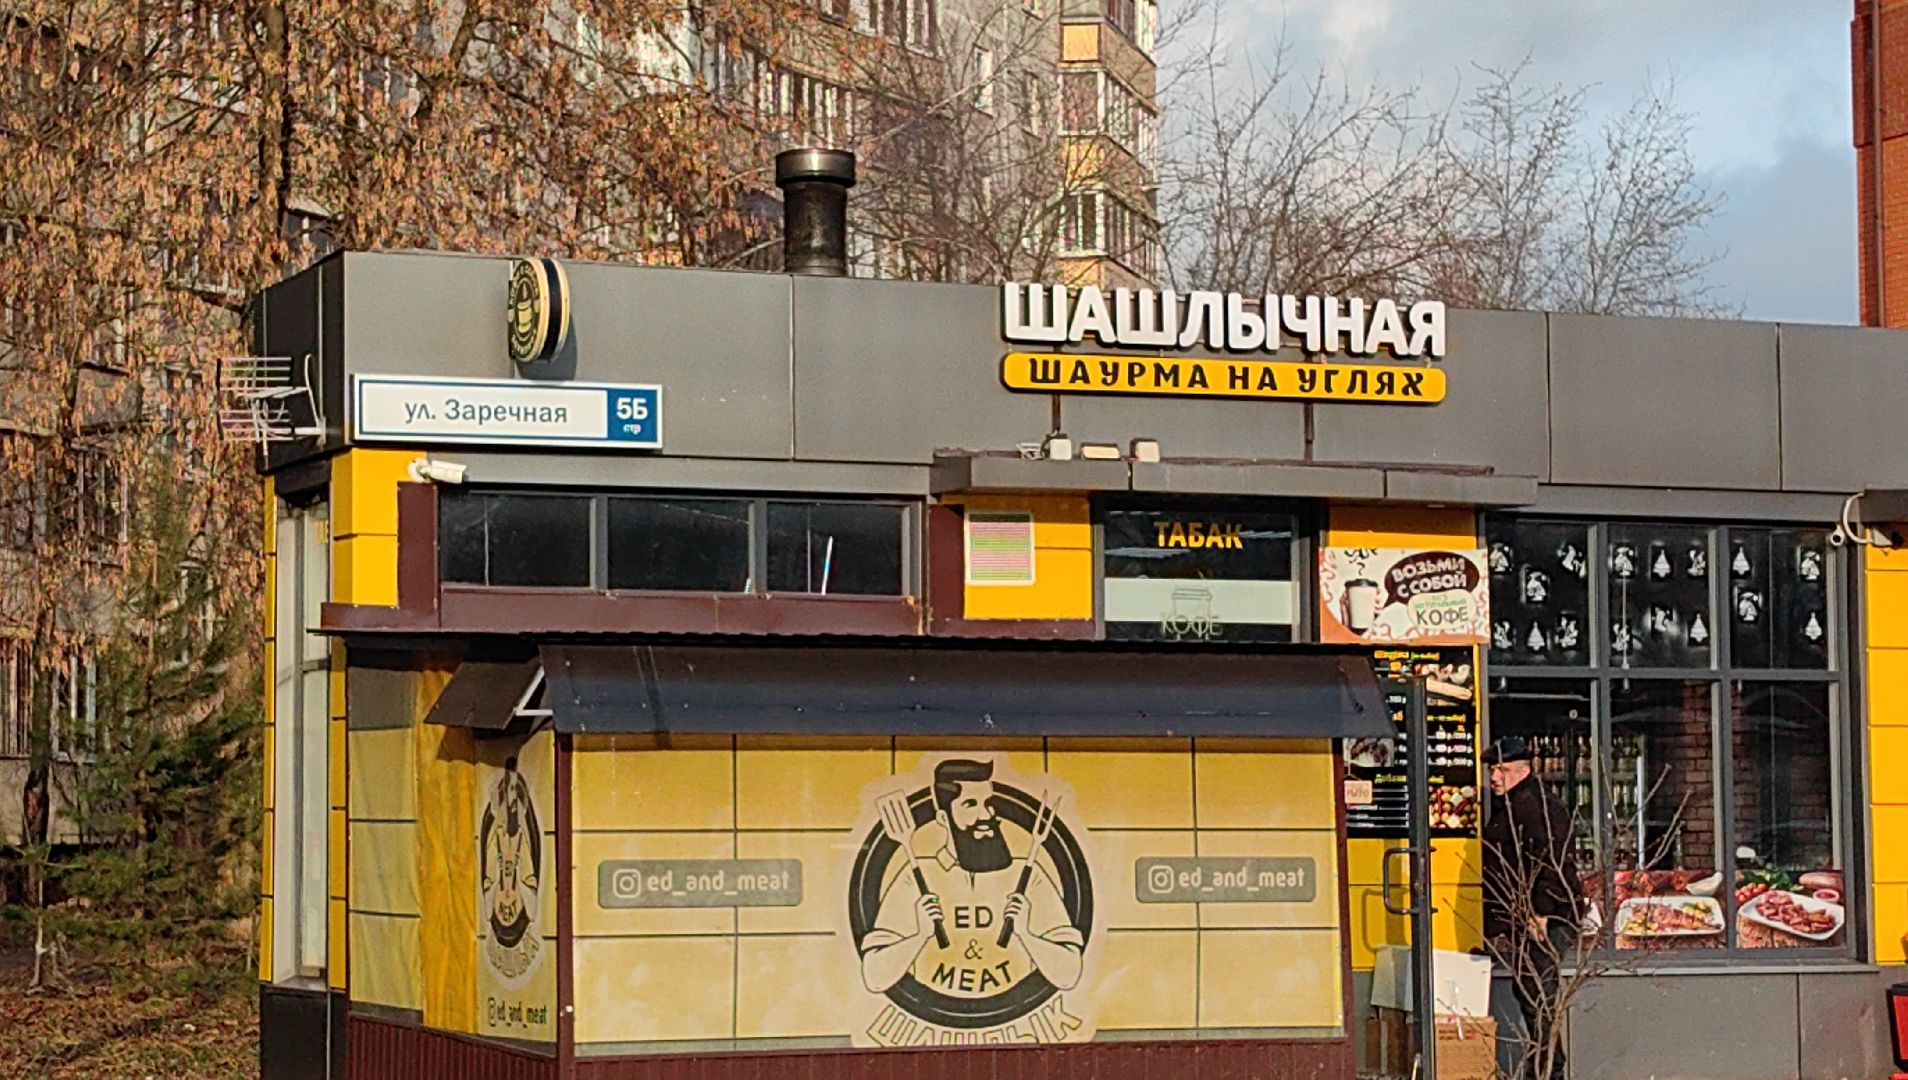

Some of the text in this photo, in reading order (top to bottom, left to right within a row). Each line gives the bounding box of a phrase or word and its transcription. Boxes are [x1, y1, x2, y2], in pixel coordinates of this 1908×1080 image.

[1004, 282, 1446, 357] ШАШЛЫЧНАЯ
[1029, 357, 1425, 397] ШАУРМА НА УГЛЯХ
[405, 398, 568, 426] ул. Заречная
[616, 397, 649, 420] 5Б
[1154, 521, 1244, 549] ТАБАК
[1391, 556, 1466, 583] ВОЗЬМИ
[1397, 570, 1467, 598] С СОБОЙ
[1160, 612, 1223, 640] КОФЕ
[1416, 606, 1470, 626] КОФЕ
[647, 869, 790, 896] ed_and_meat
[1178, 866, 1305, 893] ed_and_meat
[954, 906, 994, 929] ED
[964, 938, 984, 960] &
[931, 960, 1013, 992] MEAT
